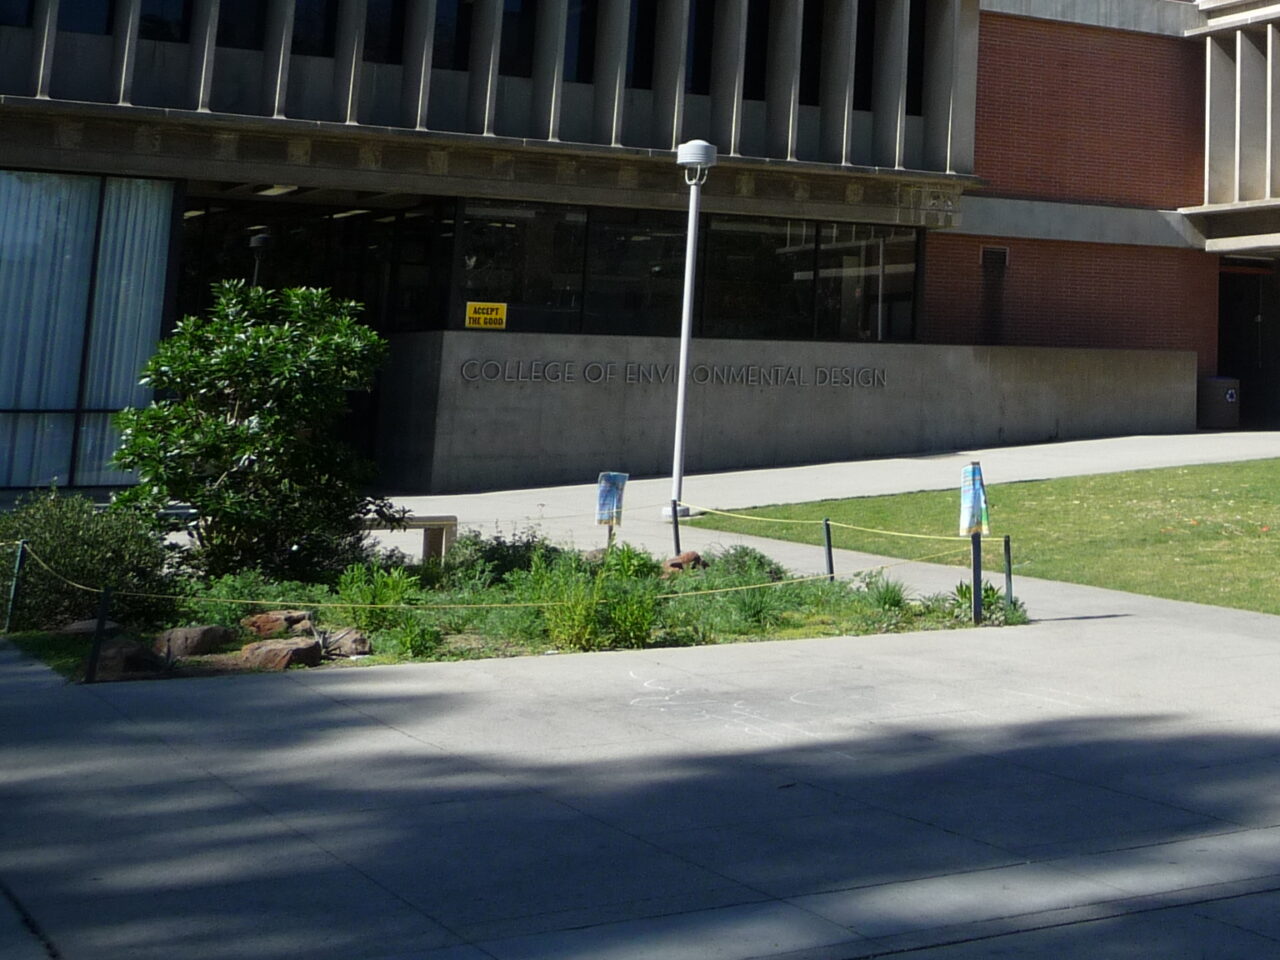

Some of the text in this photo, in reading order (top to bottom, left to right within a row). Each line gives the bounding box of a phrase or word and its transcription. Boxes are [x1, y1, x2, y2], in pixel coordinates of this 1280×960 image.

[473, 307, 499, 316] ACCEPT
[468, 317, 503, 326] THE GOOD
[461, 359, 888, 388] COLLEGE OF ENVIONMENTAL DESIGN
